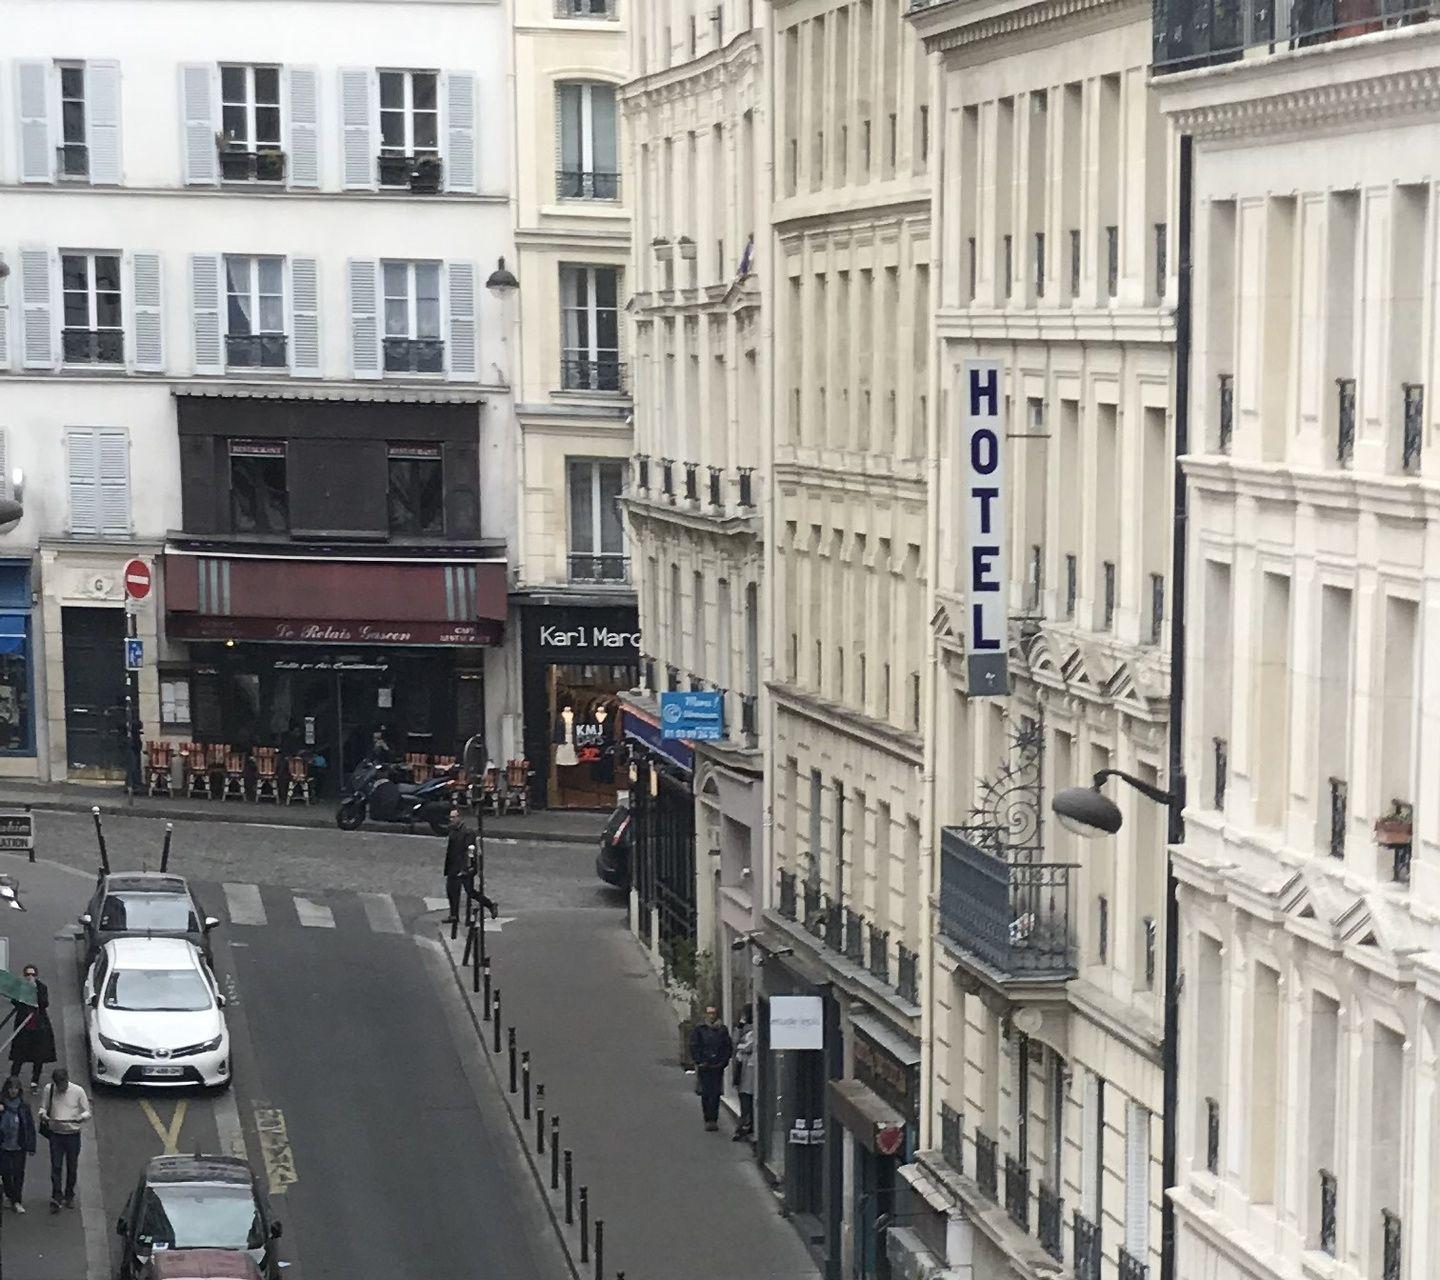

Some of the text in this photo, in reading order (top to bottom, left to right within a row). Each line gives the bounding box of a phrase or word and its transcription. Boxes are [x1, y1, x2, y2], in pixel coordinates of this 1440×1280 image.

[970, 369, 1000, 649] HOTEL
[304, 625, 351, 640] Relais
[540, 626, 588, 647] Karl
